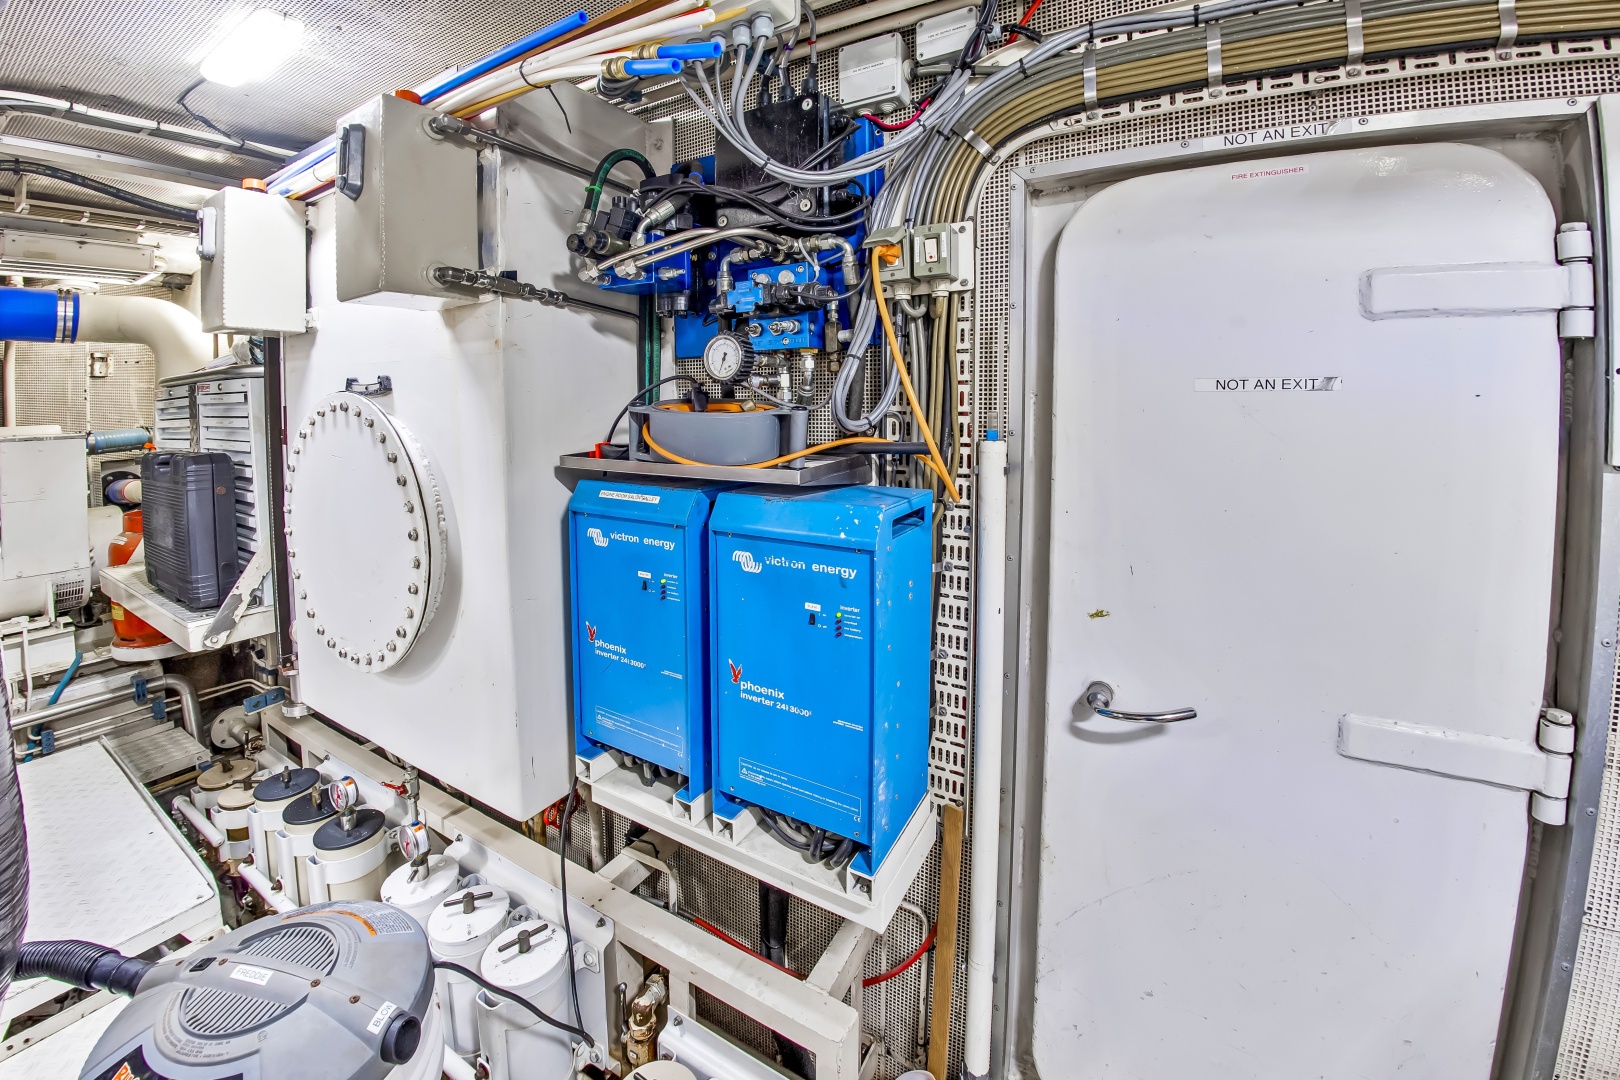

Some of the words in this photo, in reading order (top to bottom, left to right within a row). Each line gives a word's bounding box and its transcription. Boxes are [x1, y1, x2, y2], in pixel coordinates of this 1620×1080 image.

[1224, 132, 1256, 147] NOT
[1262, 129, 1285, 142] AN
[1290, 122, 1328, 138] EXIT
[1231, 172, 1248, 180] FIRE
[1250, 166, 1304, 178] EXTINGUISHER
[1216, 379, 1249, 390] NOT
[1254, 379, 1276, 390] AN
[1282, 378, 1319, 390] EXIT
[610, 531, 640, 544] victron
[644, 537, 675, 550] energy
[764, 556, 806, 570] victron
[812, 563, 857, 580] energy
[594, 639, 626, 654] phoenix
[594, 648, 619, 661] inverter
[740, 681, 784, 700] phoenix
[740, 691, 774, 706] inverter
[234, 967, 270, 984] FREDDIE
[372, 1002, 394, 1028] BLOW
